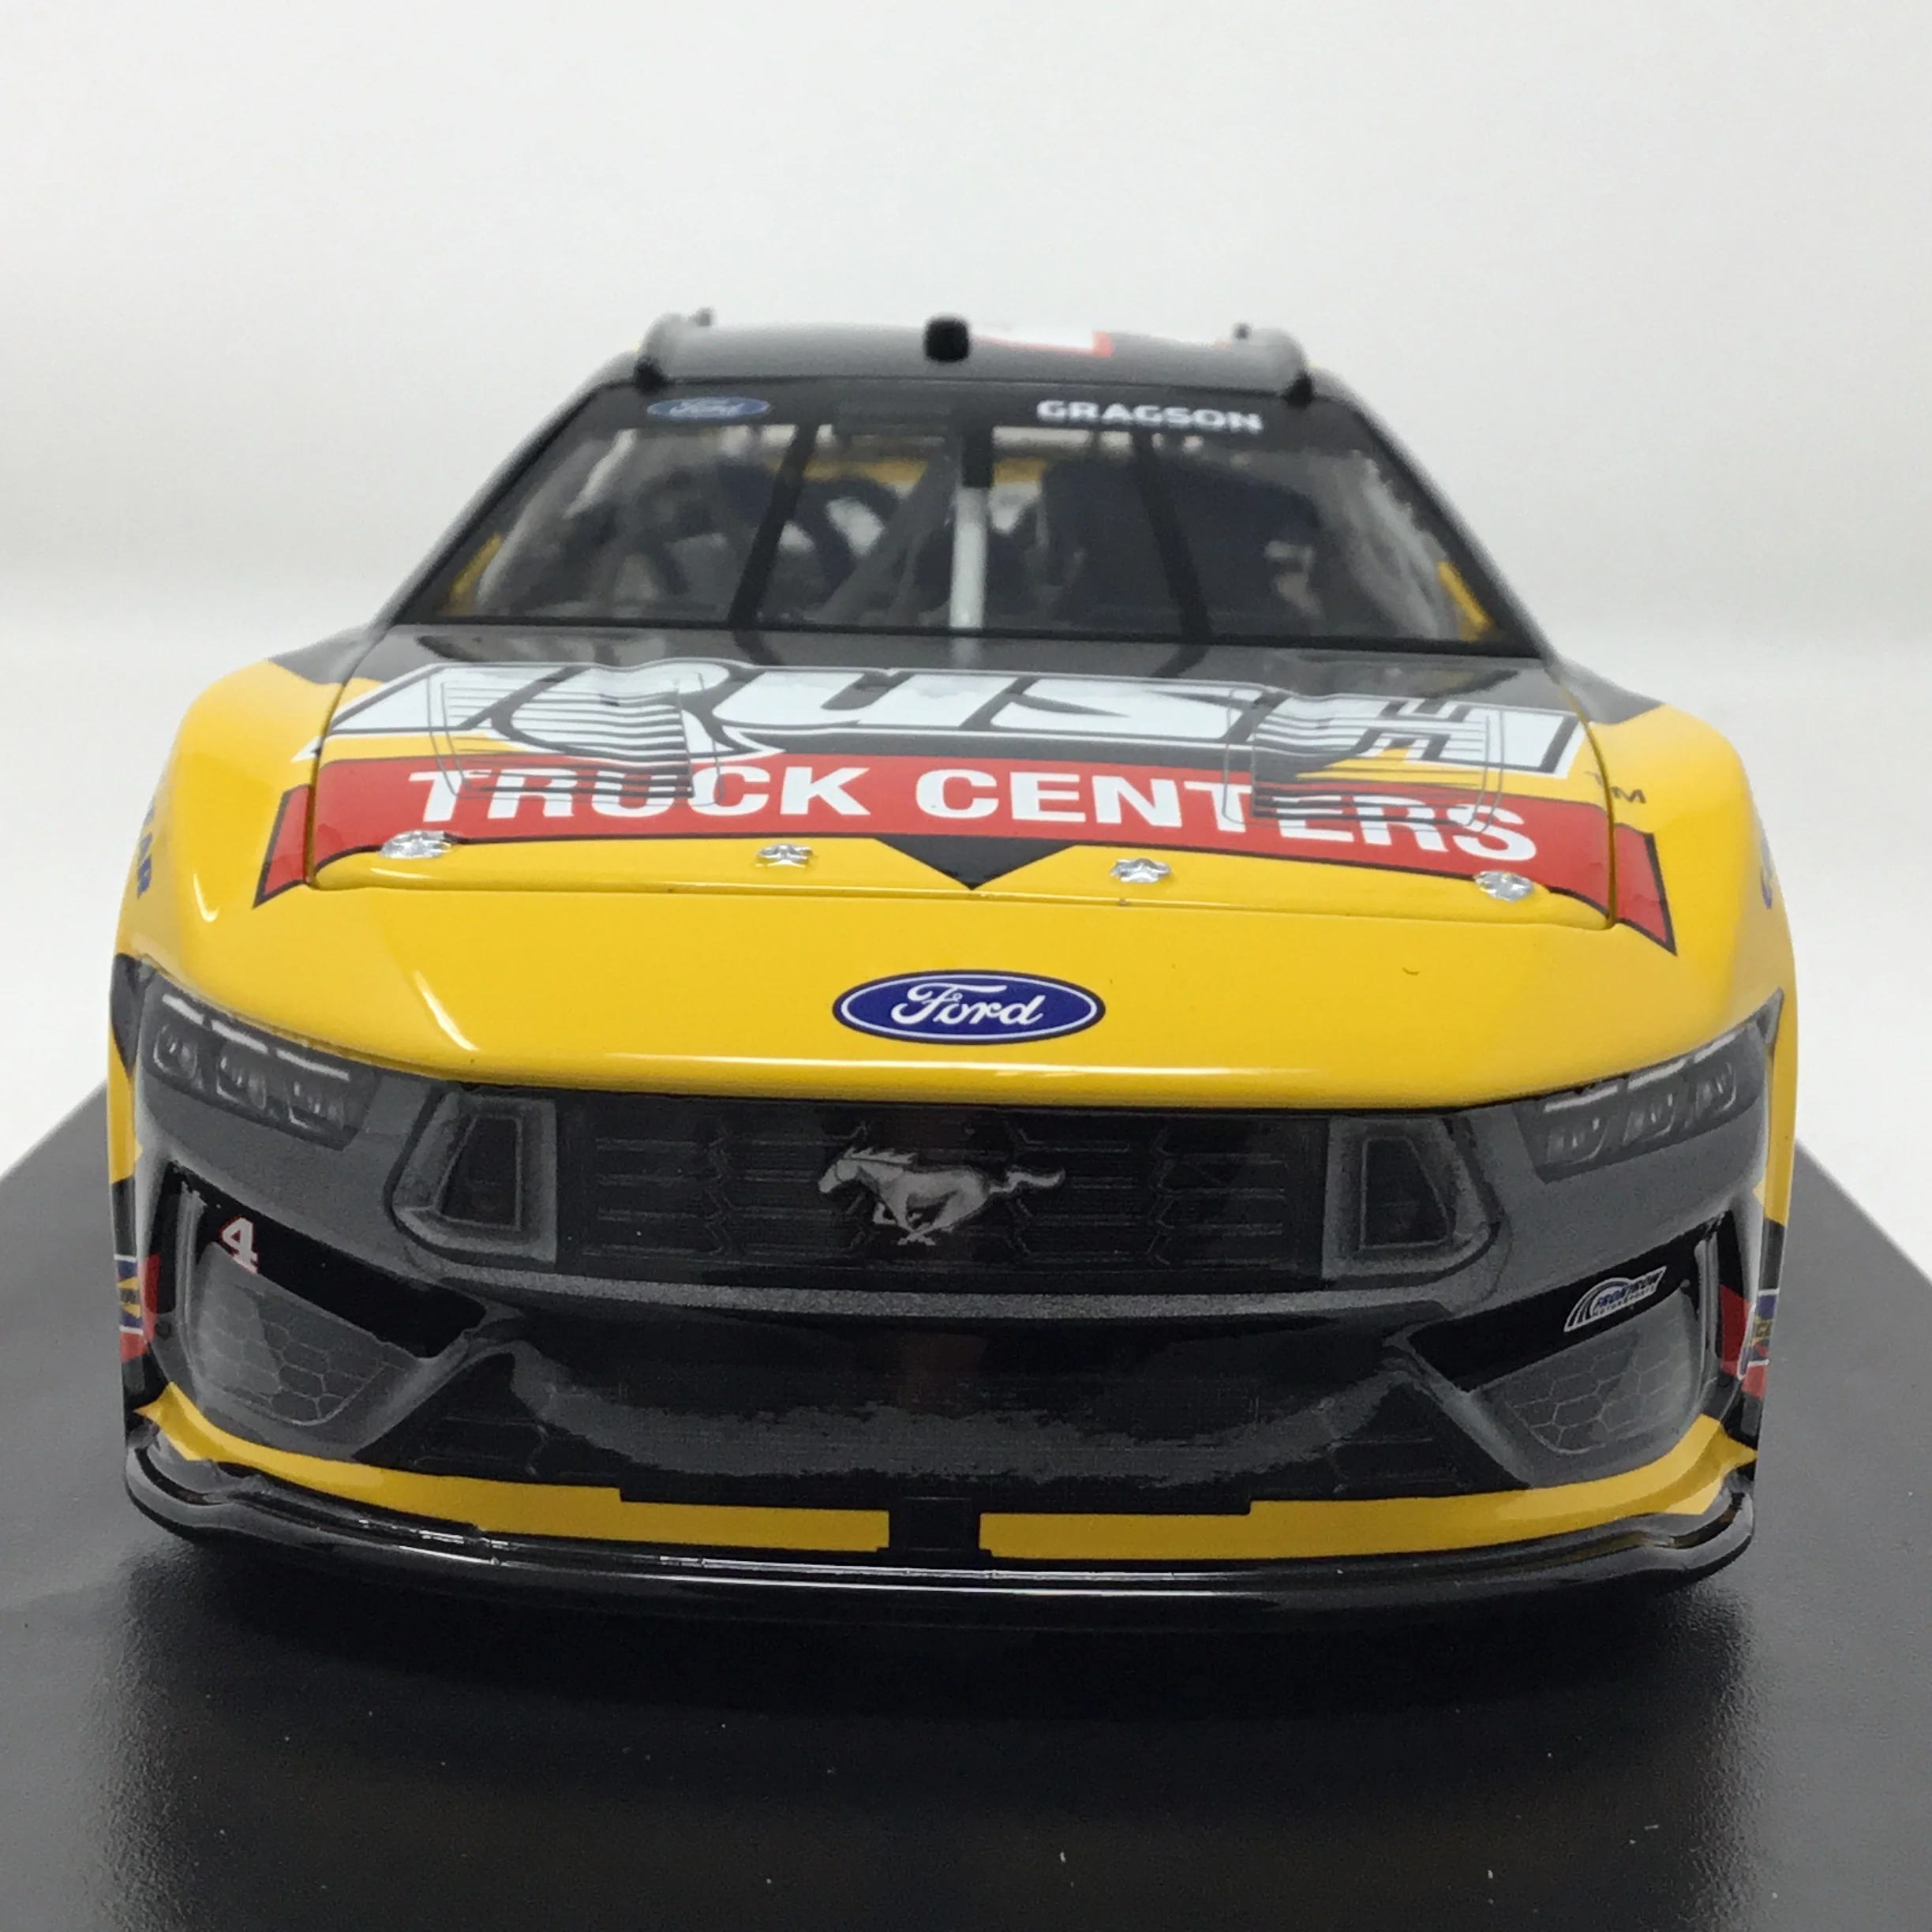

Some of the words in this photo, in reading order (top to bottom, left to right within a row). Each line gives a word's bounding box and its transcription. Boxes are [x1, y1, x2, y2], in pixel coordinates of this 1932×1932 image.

[1036, 399, 1263, 433] GRAGSON
[408, 766, 871, 822] TRUCK
[915, 769, 1537, 863] CENTERS
[891, 982, 1046, 1026] Ford
[221, 1216, 260, 1275] 4
